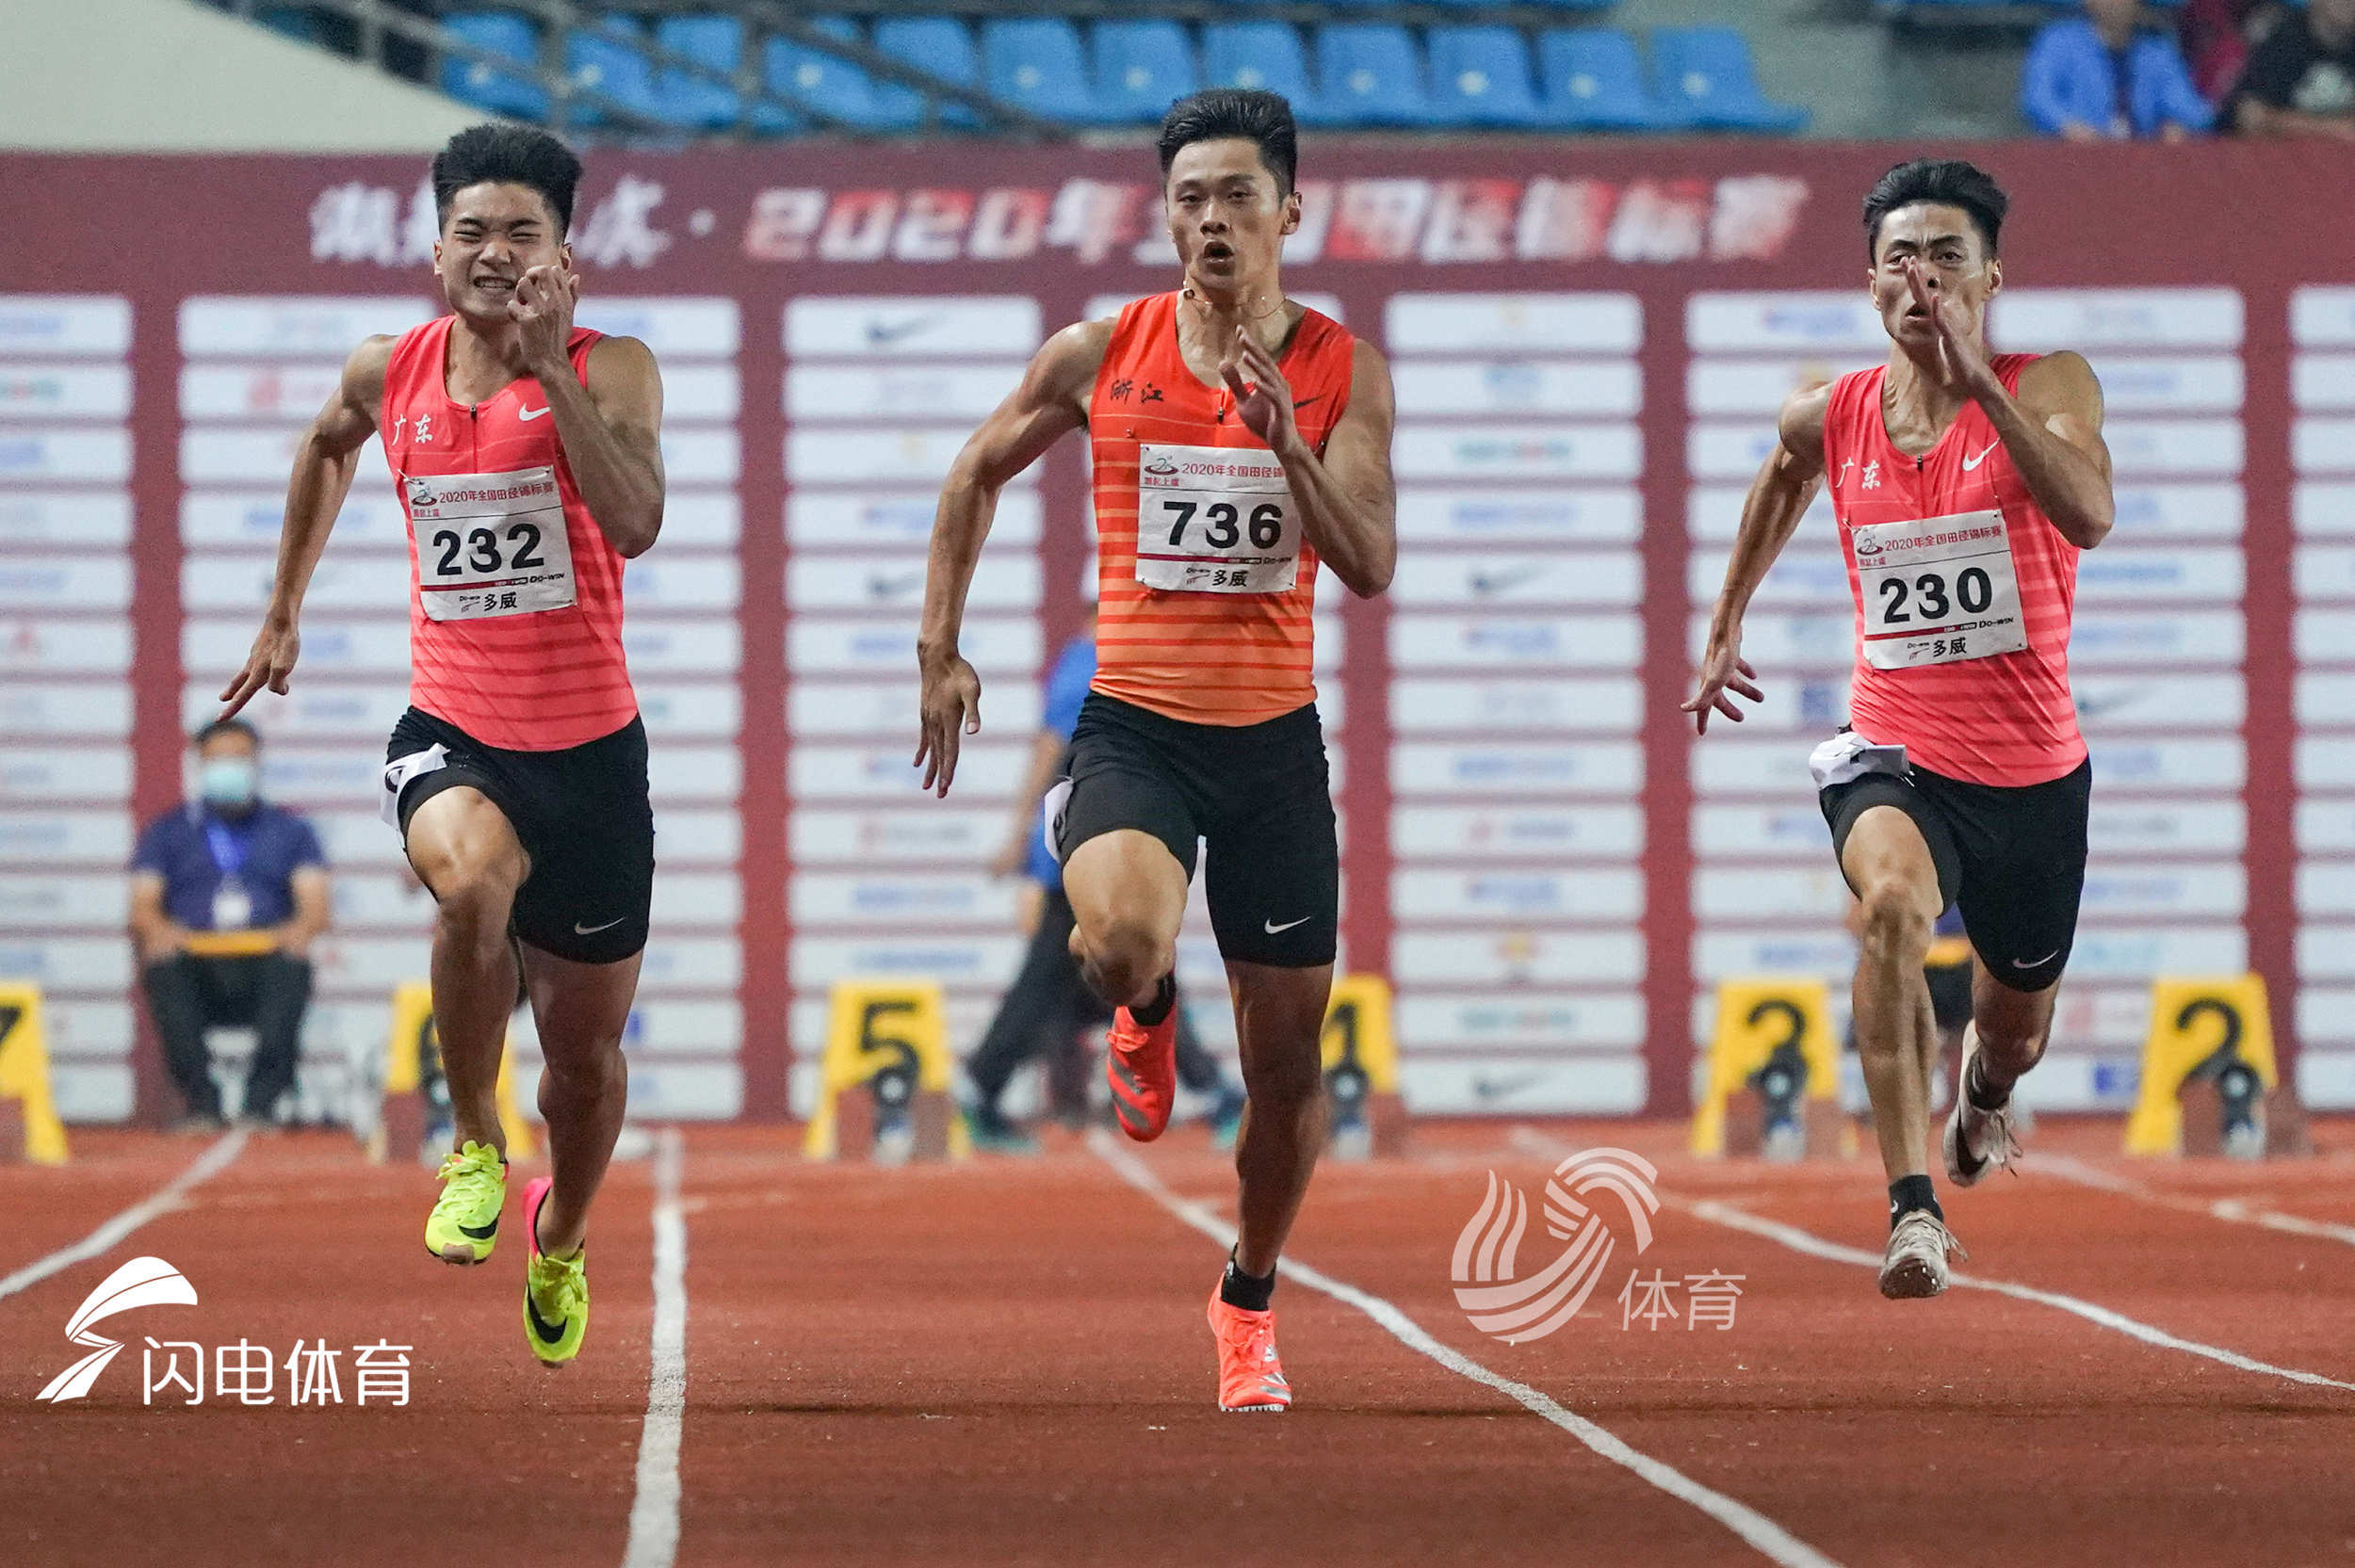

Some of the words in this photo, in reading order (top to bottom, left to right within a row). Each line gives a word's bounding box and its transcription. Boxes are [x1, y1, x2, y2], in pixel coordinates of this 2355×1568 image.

[1110, 379, 1164, 405] 浙江
[391, 414, 433, 446] 广东
[1835, 458, 1881, 491] 广东
[1163, 501, 1284, 550] 736
[432, 523, 544, 576] 232
[1211, 569, 1249, 588] 多威
[483, 591, 517, 612] 多威
[1879, 567, 1992, 624] 230
[1932, 637, 1967, 658] 多威
[859, 999, 921, 1089] 5
